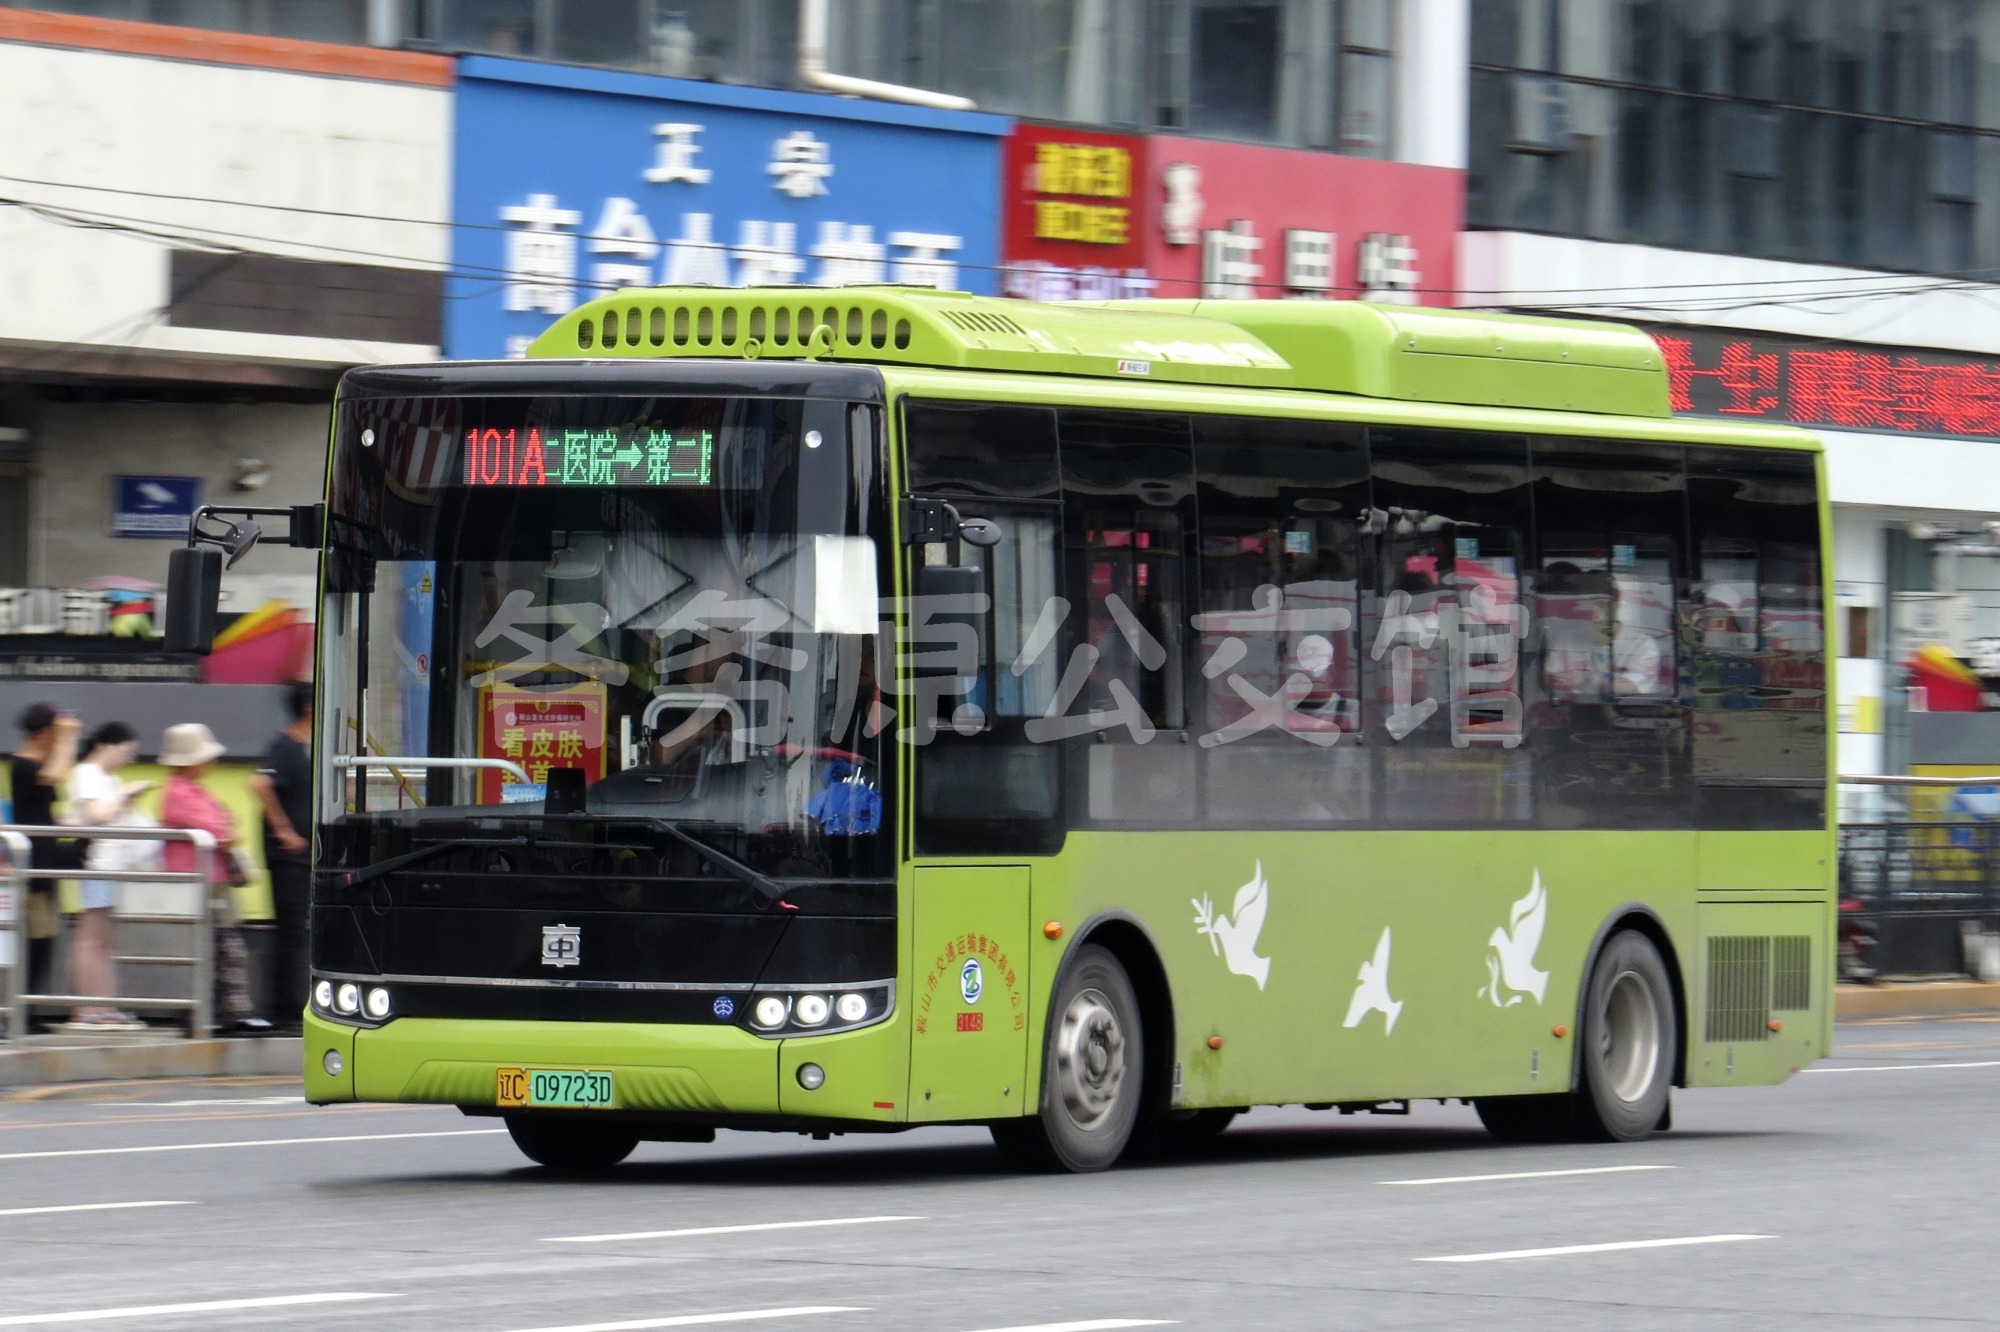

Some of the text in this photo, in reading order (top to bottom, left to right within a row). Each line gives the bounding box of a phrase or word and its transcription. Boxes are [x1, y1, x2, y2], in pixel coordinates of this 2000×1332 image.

[467, 428, 546, 485] 101A
[501, 728, 583, 758] 看皮肤
[500, 1073, 611, 1102] 辽C 09723D
